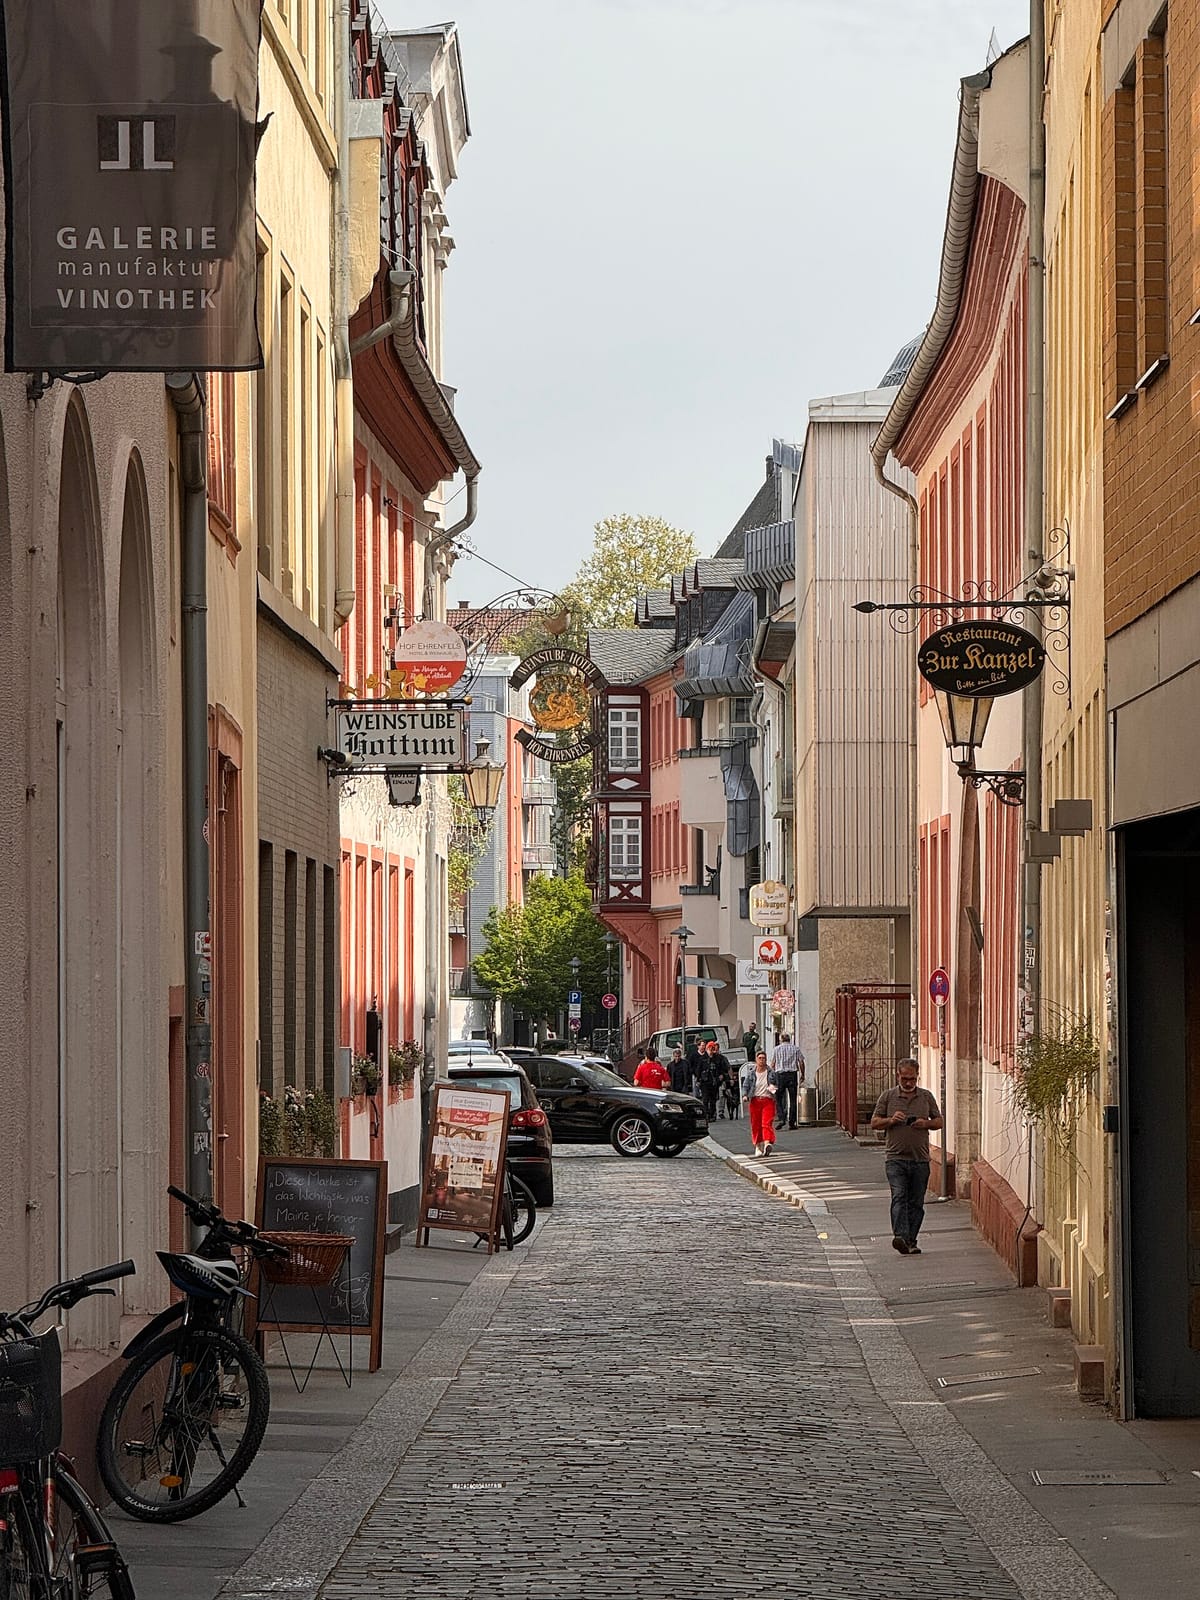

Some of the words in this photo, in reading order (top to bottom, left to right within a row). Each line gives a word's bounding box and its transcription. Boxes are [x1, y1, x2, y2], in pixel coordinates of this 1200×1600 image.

[56, 226, 217, 250] GALERIE
[57, 256, 216, 276] manufaktur
[56, 288, 217, 310] VINOTHEK
[399, 642, 417, 650] HOF
[417, 642, 462, 650] EHRENFELS
[940, 627, 1022, 648] Restaurant
[517, 649, 568, 675] WEINSTUBE
[569, 652, 597, 678] HOTEL
[925, 650, 960, 674] Zur
[963, 643, 1037, 674] Kanzel
[990, 672, 1007, 682] Bit
[344, 713, 457, 730] WEINSTUBE
[526, 738, 545, 755] HOF
[544, 740, 591, 761] EHRENFELS
[571, 992, 579, 1003] P
[275, 1191, 295, 1201] das
[276, 1207, 310, 1223] Mainz
